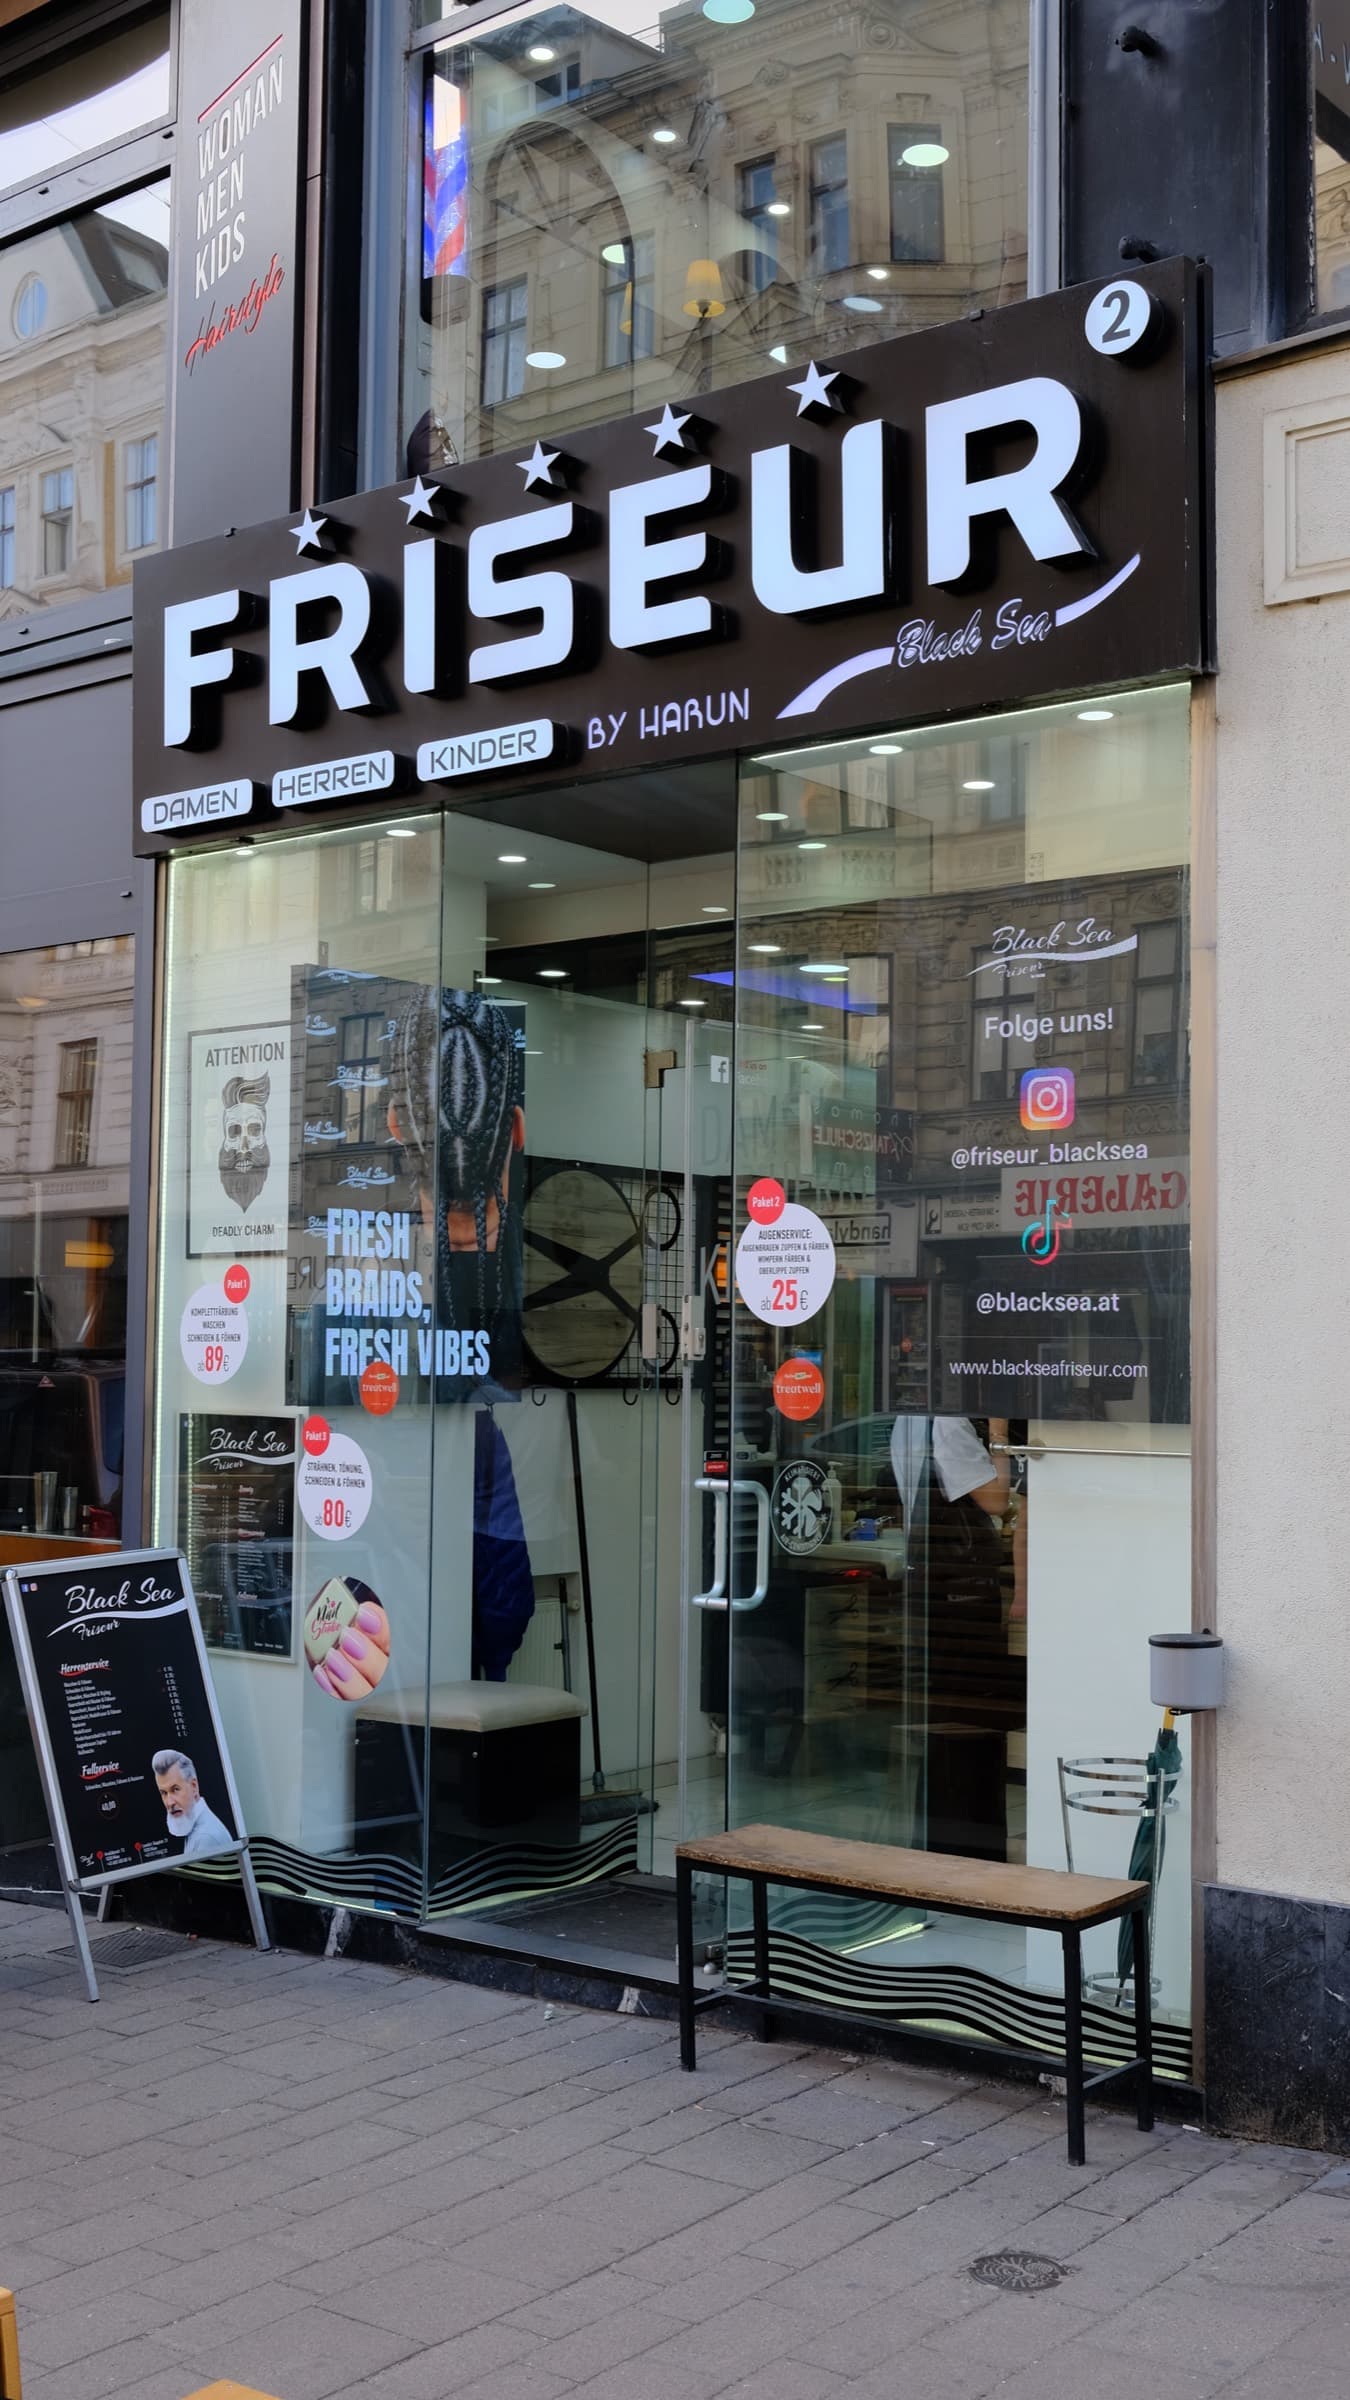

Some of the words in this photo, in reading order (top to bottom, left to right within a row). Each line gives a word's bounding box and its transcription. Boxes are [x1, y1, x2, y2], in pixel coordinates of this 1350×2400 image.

[199, 54, 284, 180] WOMAN
[197, 153, 245, 241] MEN
[195, 211, 246, 300] KIDS
[185, 252, 285, 376] Hairstyle
[1101, 289, 1131, 344] 2
[163, 377, 1083, 747] FRISEUR
[895, 609, 984, 669] Black
[990, 598, 1051, 651] Sea
[587, 711, 628, 750] BY
[639, 688, 750, 740] HARUN
[430, 728, 537, 774] KINDER
[278, 757, 387, 801] HERREN
[152, 788, 238, 825] DAMEN
[992, 920, 1066, 954] Black
[1066, 917, 1116, 947] Sea
[984, 1014, 1054, 1042] Folge
[1060, 1008, 1114, 1033] uns!
[205, 1041, 285, 1068] ATTENTION
[951, 1141, 1148, 1169] @friseur_blacksea
[752, 1196, 773, 1208] Paket
[774, 1196, 781, 1206] 2
[212, 1225, 242, 1238] DEADLY
[244, 1224, 275, 1236] CHARM
[326, 1207, 410, 1259] FRESH
[758, 1228, 813, 1240] AUGENSERVICE:
[226, 1280, 244, 1289] Paket
[325, 1267, 432, 1324] BRAIDS,
[976, 1291, 1120, 1315] @blacksea.at
[202, 1320, 226, 1329] WASCHEN
[325, 1328, 409, 1377] FRESH
[416, 1329, 491, 1377] VIBES
[949, 1359, 1149, 1378] www.blackseafriseur.com
[776, 1383, 822, 1395] treatwell
[209, 1427, 258, 1452] Black
[257, 1430, 289, 1453] Sea
[305, 1430, 321, 1441] Paket
[65, 1580, 131, 1614] Black
[134, 1577, 176, 1605] Sea
[72, 1618, 121, 1640] Friseur
